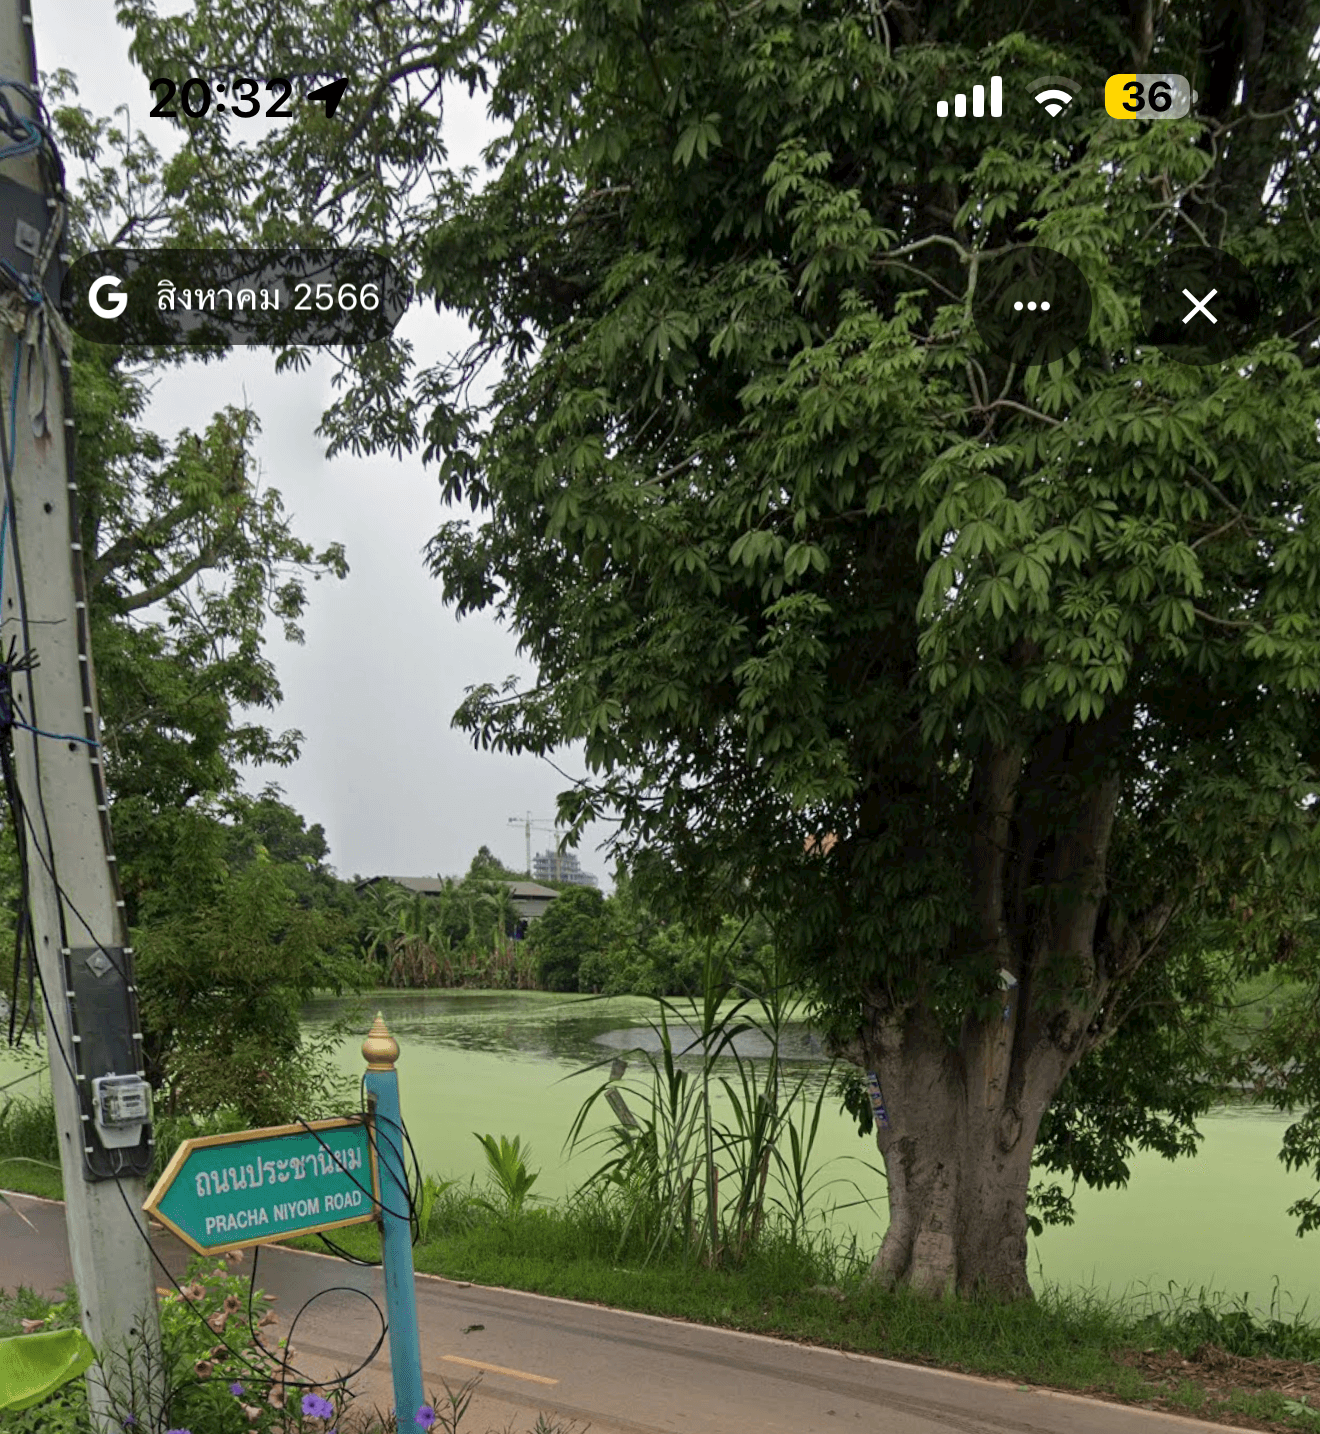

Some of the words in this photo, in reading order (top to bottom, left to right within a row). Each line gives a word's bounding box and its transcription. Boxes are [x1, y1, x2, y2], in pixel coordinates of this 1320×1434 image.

[194, 1143, 363, 1198] ถนนประชานิยม
[205, 1205, 270, 1236] PRACHA
[273, 1197, 320, 1223] NIYOM
[324, 1190, 363, 1213] ROAD
